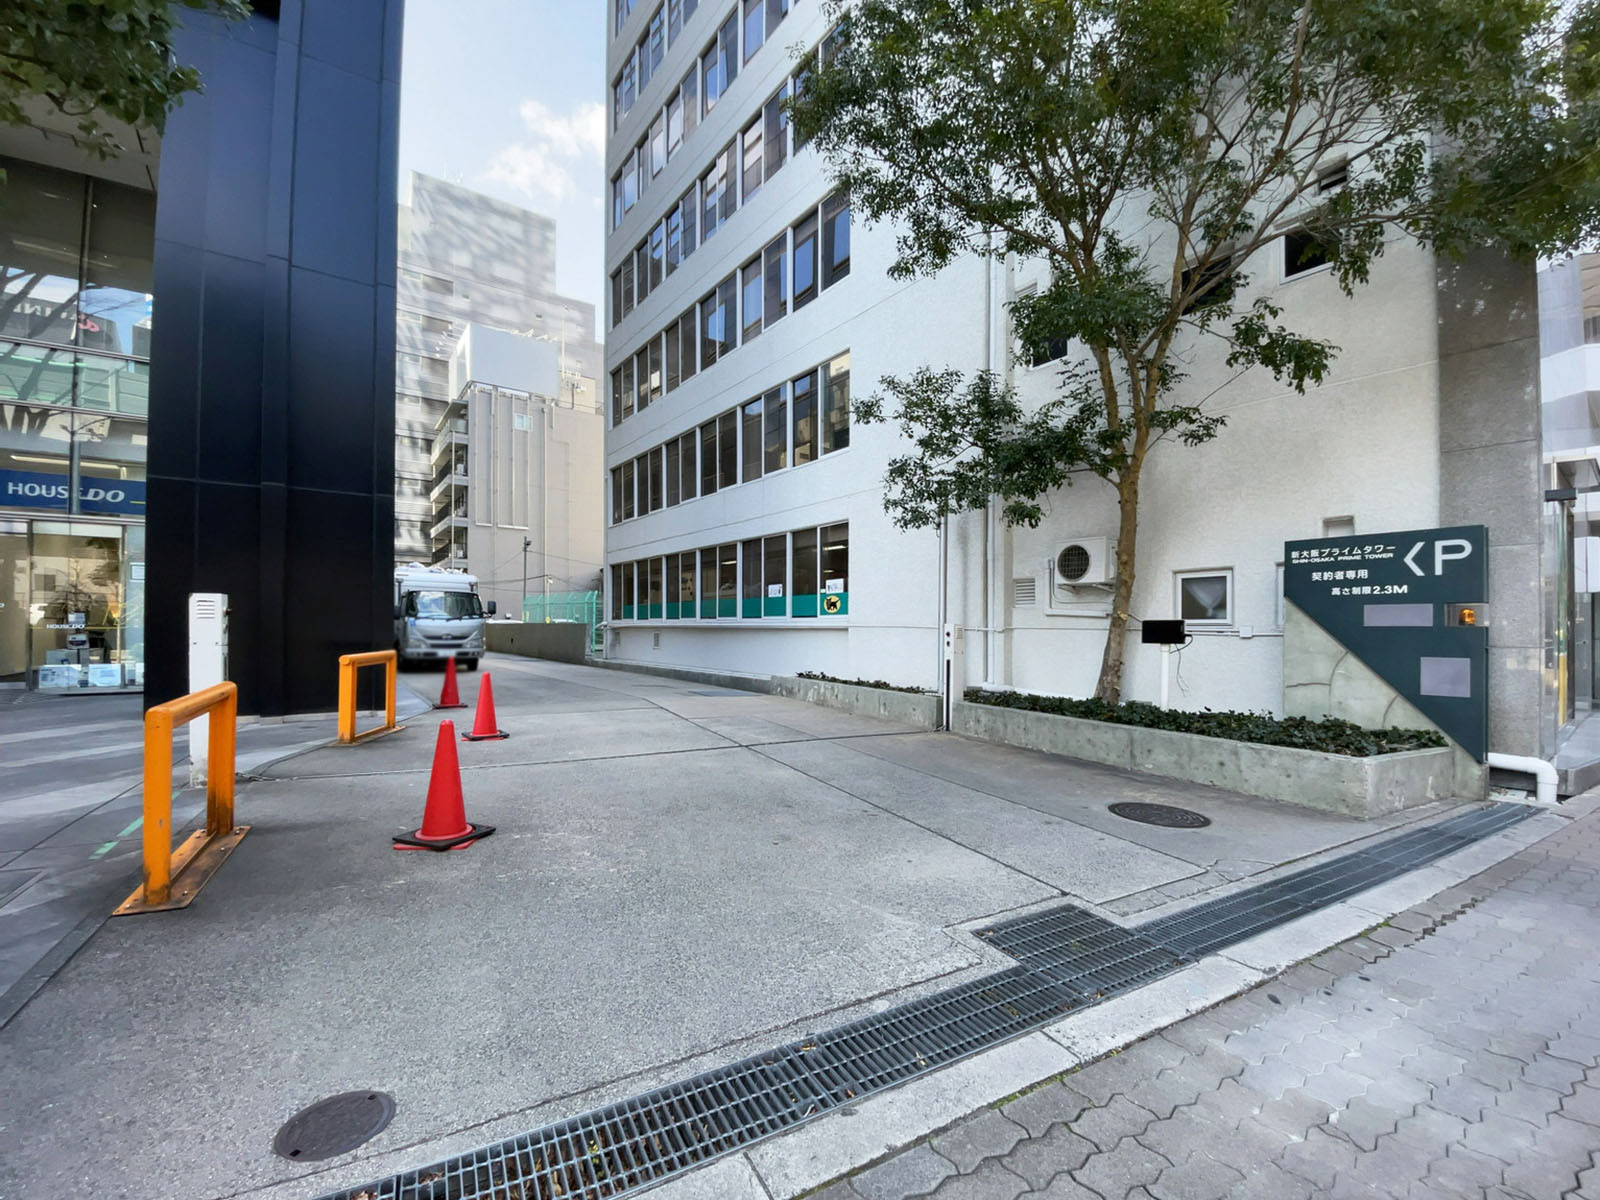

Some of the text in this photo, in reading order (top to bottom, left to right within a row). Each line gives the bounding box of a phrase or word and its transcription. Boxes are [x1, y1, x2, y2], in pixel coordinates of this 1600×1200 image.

[1291, 544, 1396, 559] 新大阪プライムタワー
[1365, 552, 1394, 560] TOWER
[1434, 539, 1473, 576] P
[1311, 569, 1368, 581] 契約者専用
[1331, 585, 1408, 596] 高さ制限2.3M
